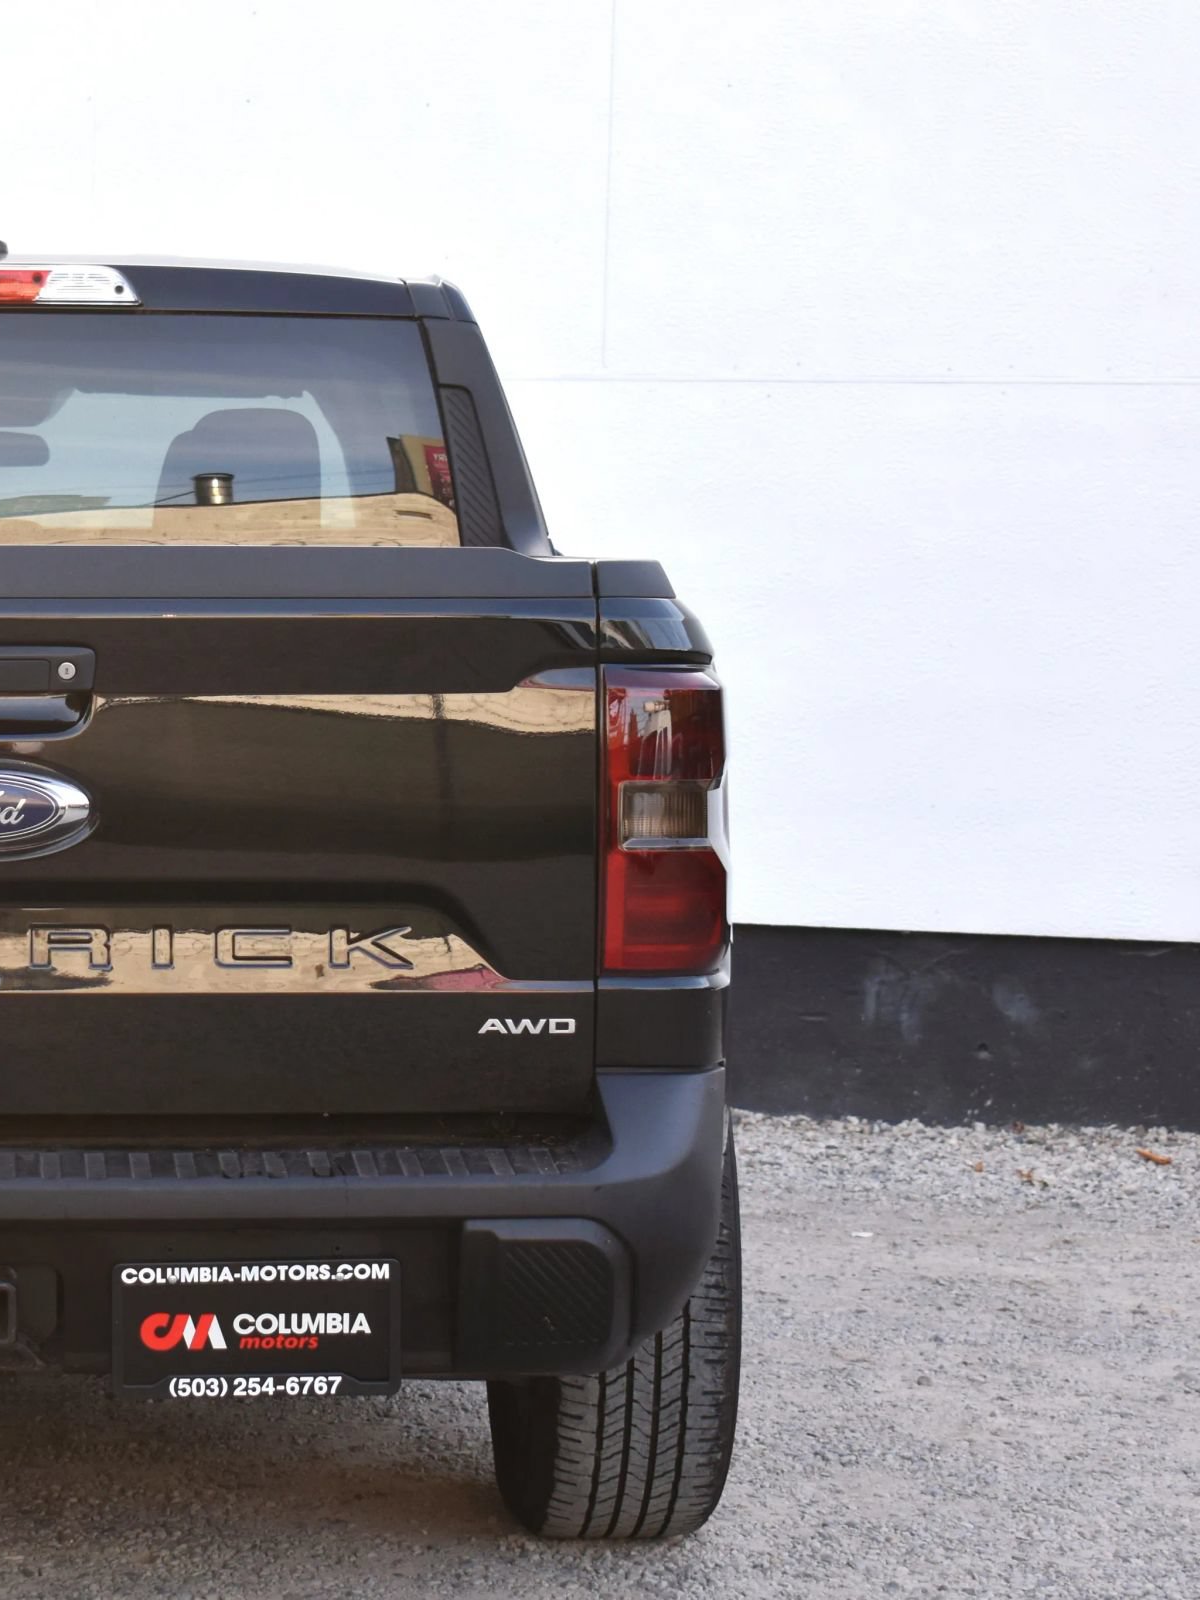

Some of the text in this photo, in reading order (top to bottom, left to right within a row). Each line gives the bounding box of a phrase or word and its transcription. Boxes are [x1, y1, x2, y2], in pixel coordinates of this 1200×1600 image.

[478, 1017, 576, 1034] AWD
[120, 1263, 390, 1284] COLUMBIA-MOTORS.COM
[233, 1313, 371, 1334] COLUMBIA
[239, 1335, 319, 1349] motors
[169, 1376, 342, 1397] (503) 254-6767
